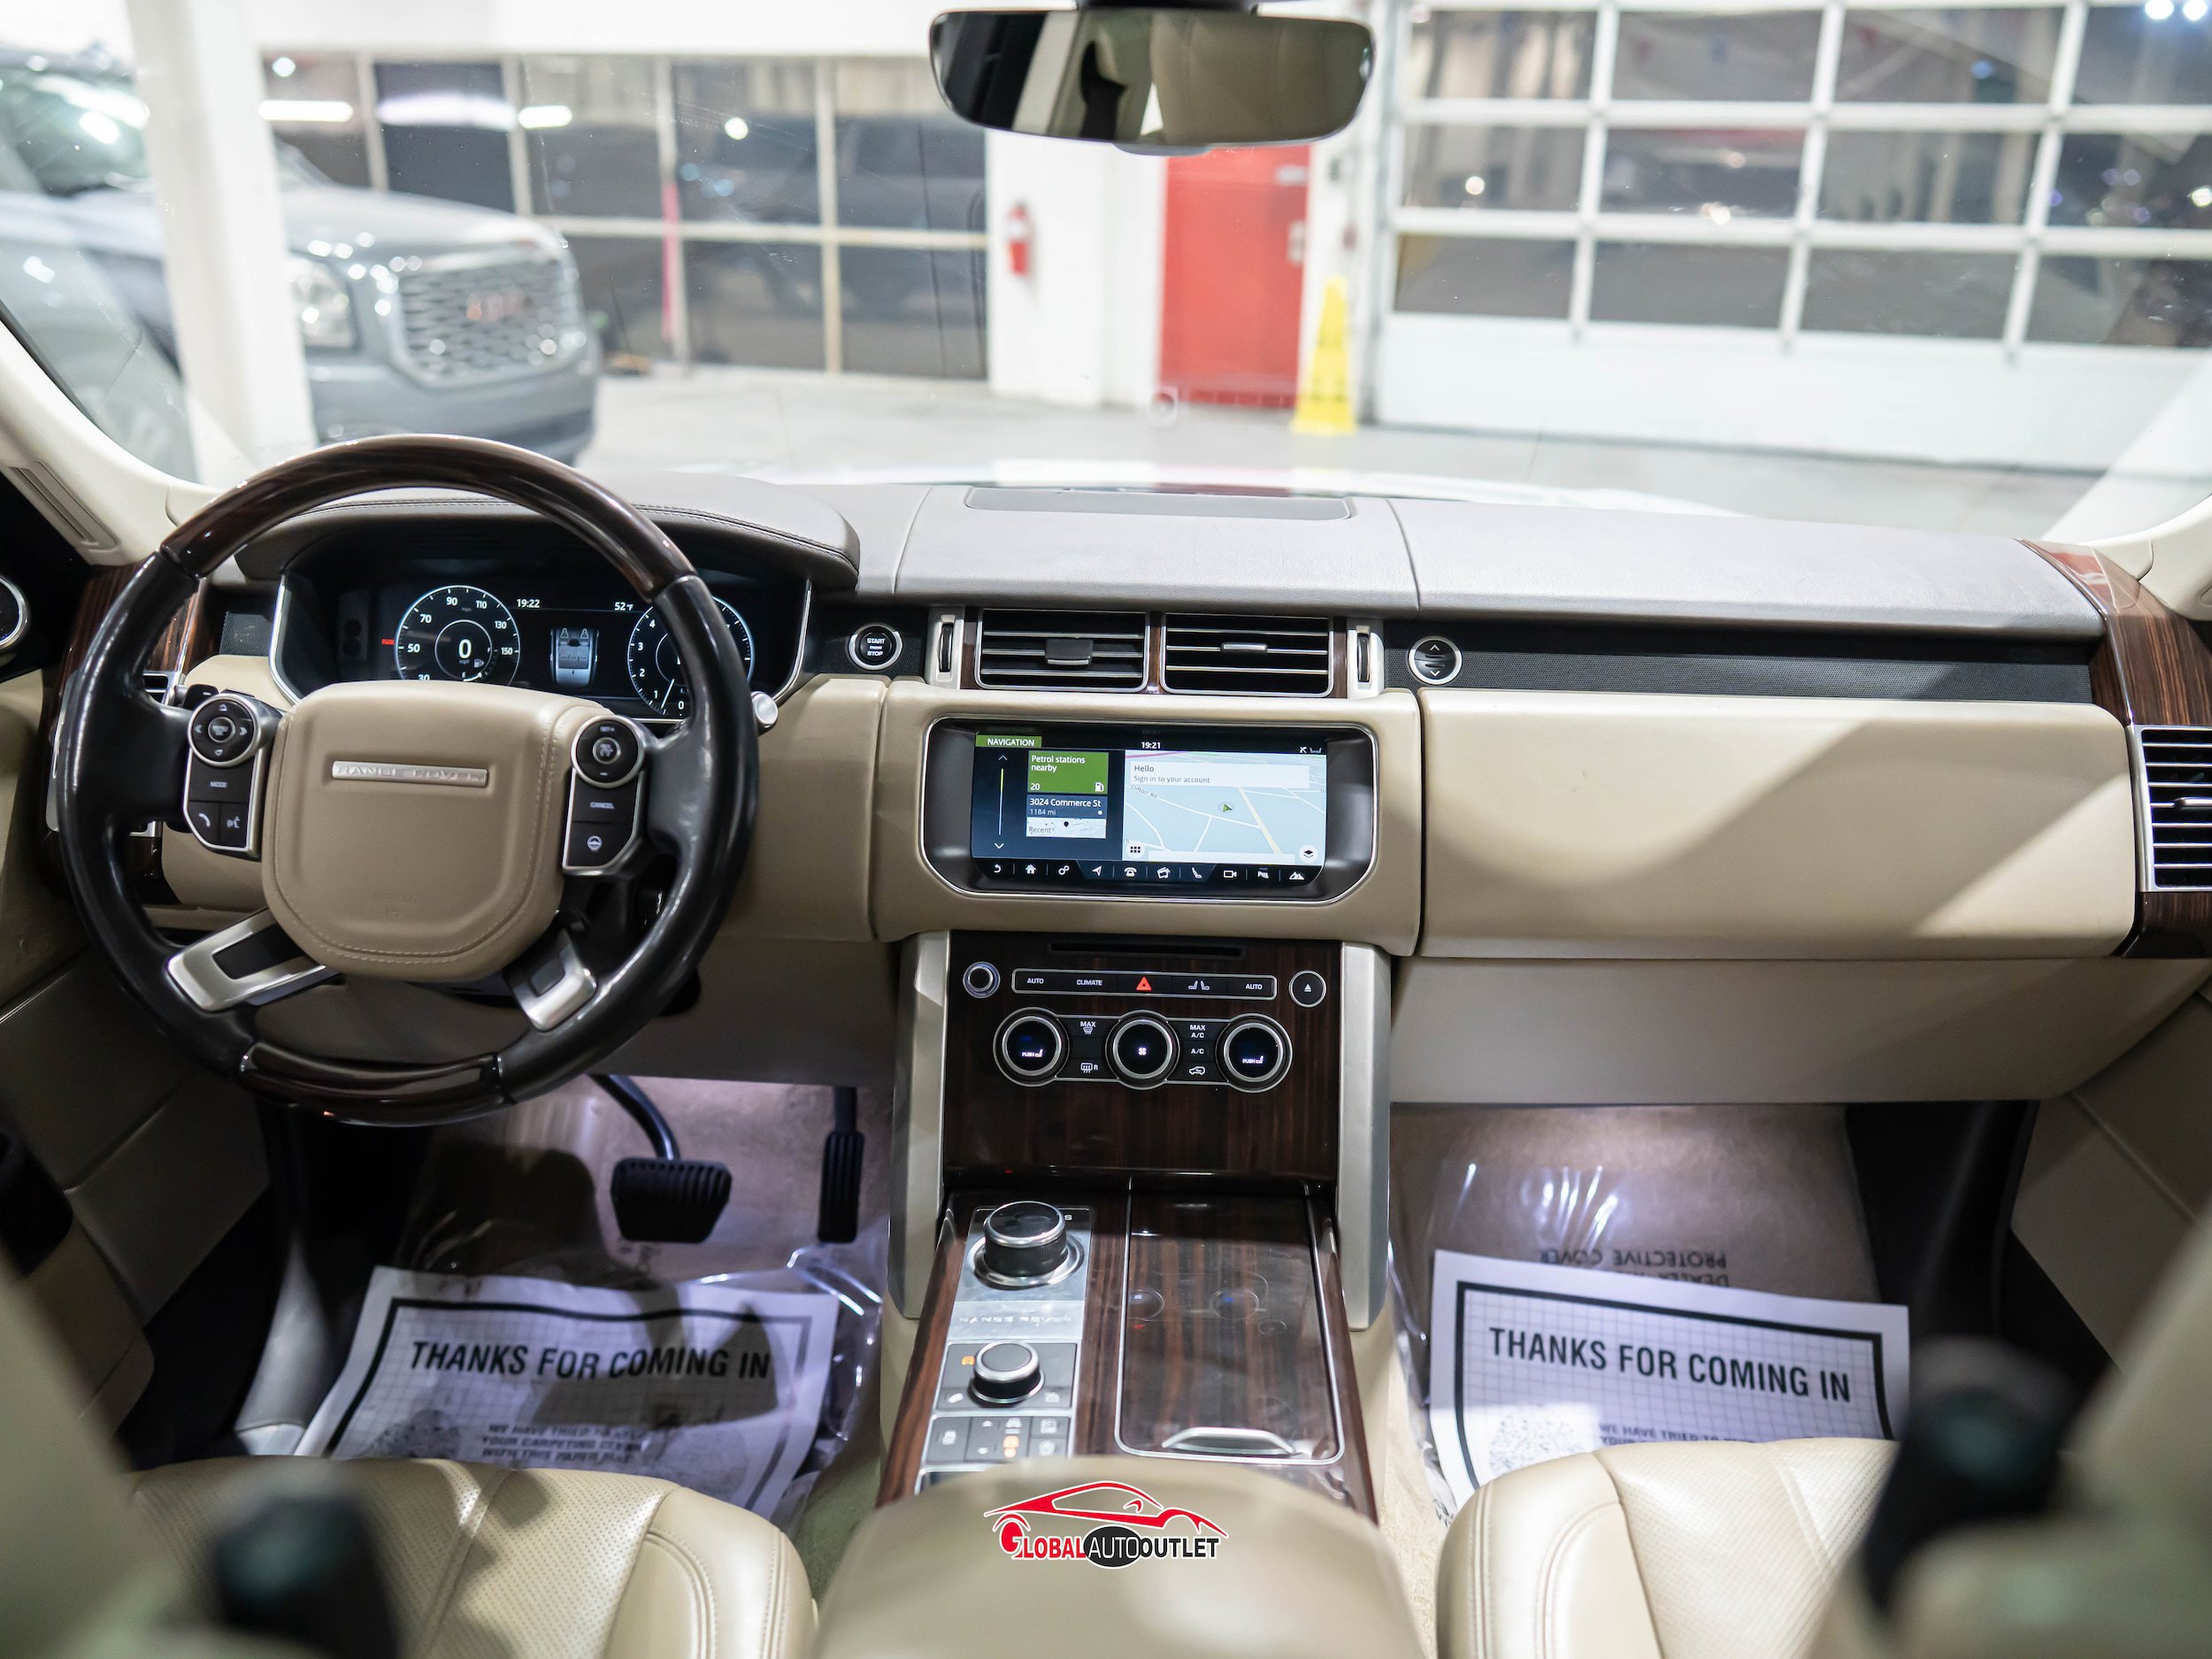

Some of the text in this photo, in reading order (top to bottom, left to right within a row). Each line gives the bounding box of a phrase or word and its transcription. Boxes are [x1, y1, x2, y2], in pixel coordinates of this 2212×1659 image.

[446, 596, 458, 606] 90
[476, 600, 488, 610] 110
[517, 599, 541, 609] 19:22
[419, 614, 432, 624] 70
[649, 619, 656, 628] 4
[495, 620, 507, 629] 130
[407, 643, 420, 653] 50
[458, 639, 472, 659] 0
[501, 647, 513, 656] 150
[637, 642, 643, 651] 3
[639, 668, 646, 678] 2
[653, 690, 658, 699] 1
[678, 701, 685, 710] 0
[987, 738, 1035, 747] NAVIGATION
[1031, 764, 1057, 773] nearby
[1050, 798, 1092, 807] Commerce
[1613, 1249, 1727, 1269] PROTECTIVE
[410, 1340, 771, 1379] THANKS FOR COMING IN
[1489, 1328, 1851, 1403] THANKS FOR COMING IN
[1623, 1425, 1657, 1439] HAVE
